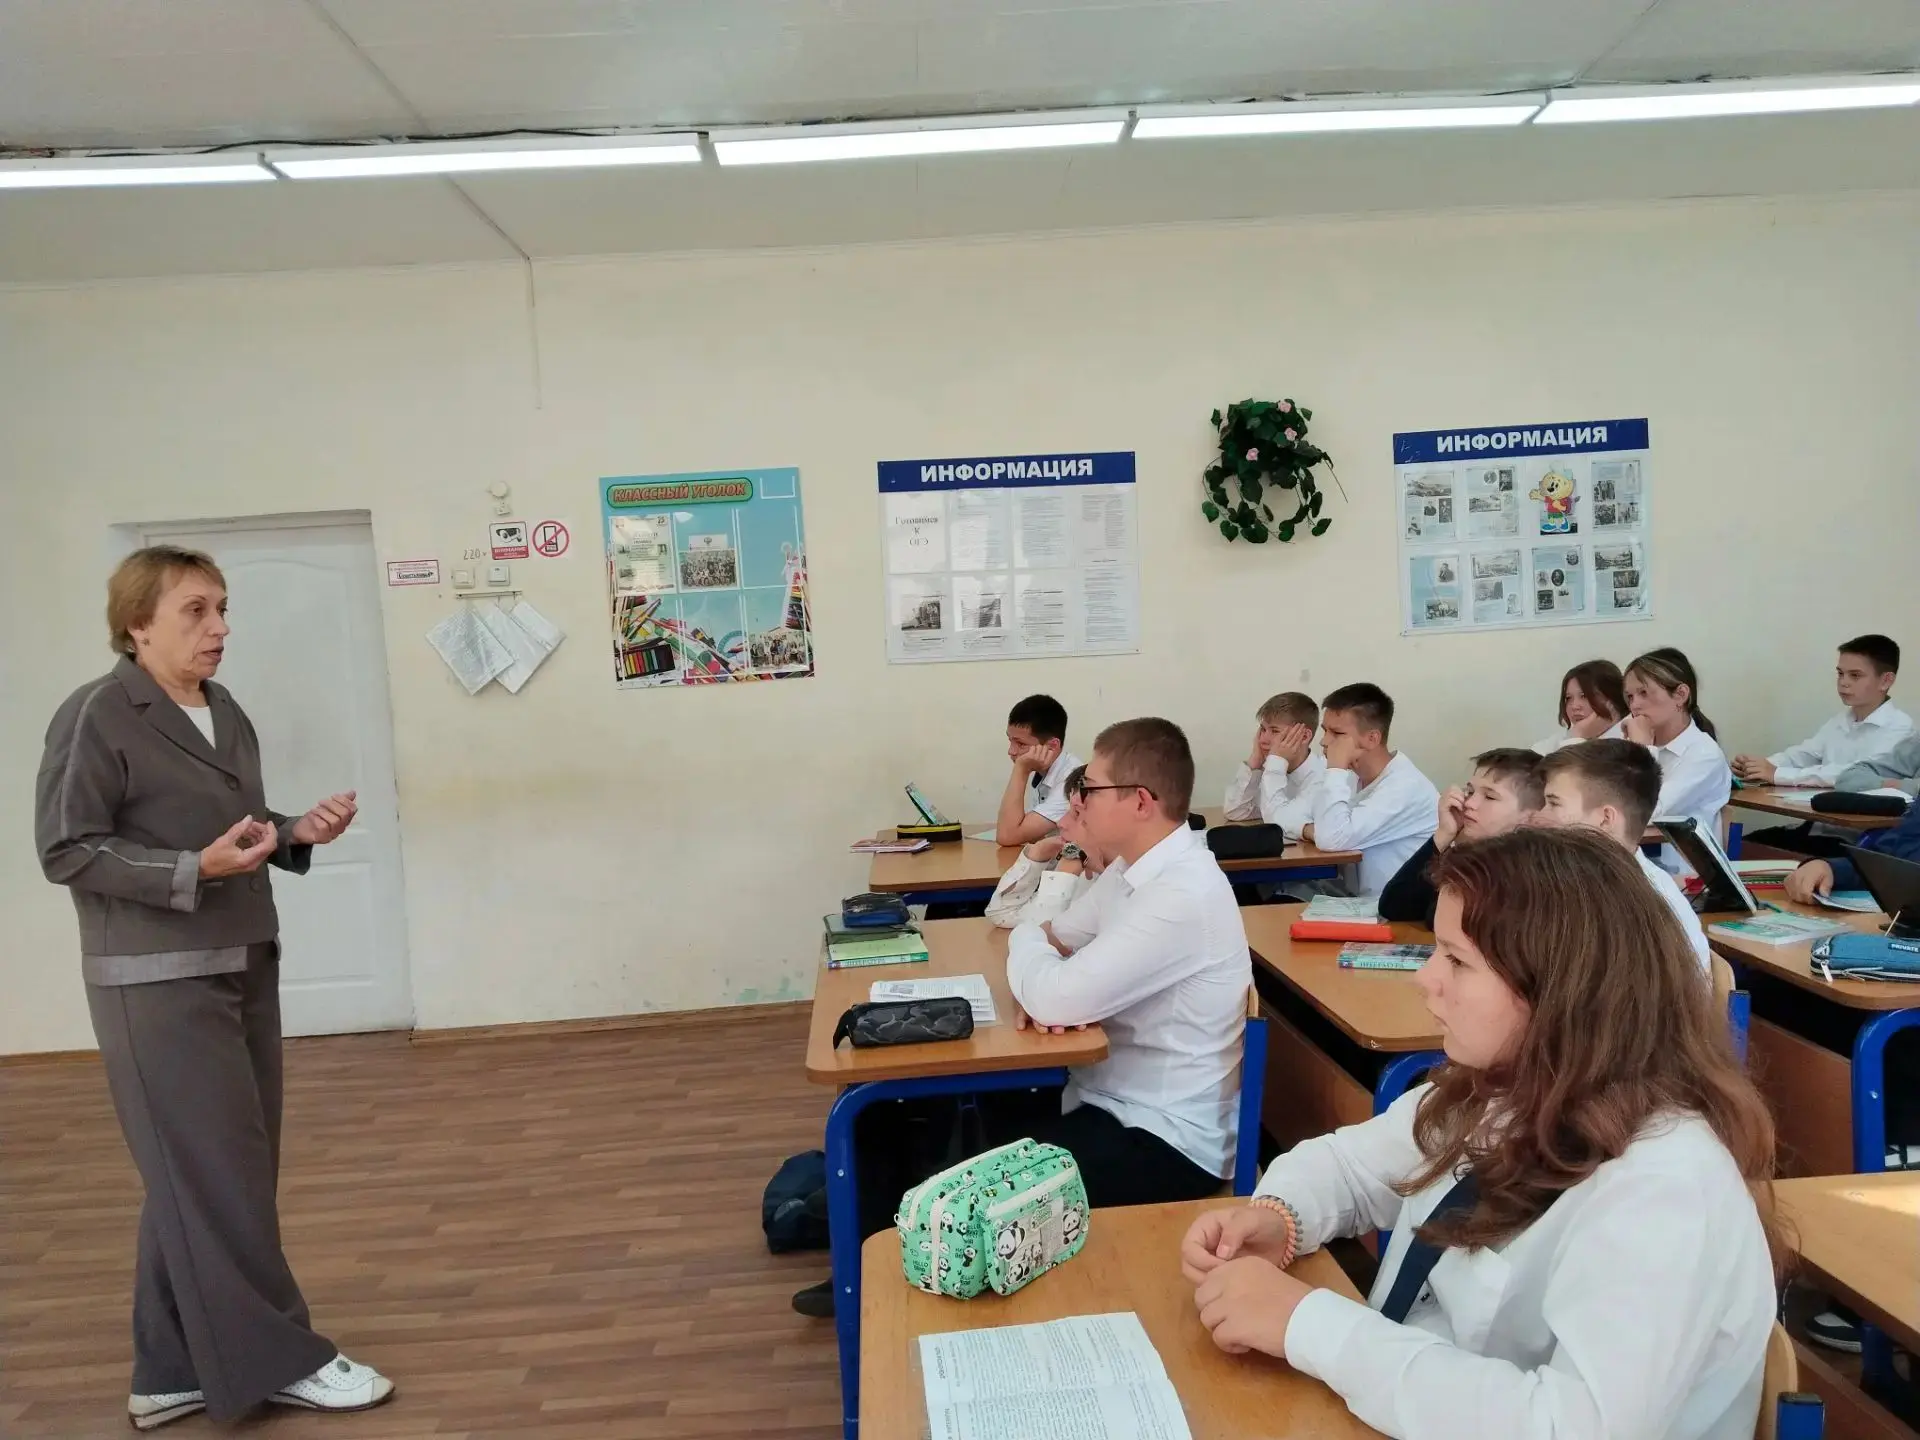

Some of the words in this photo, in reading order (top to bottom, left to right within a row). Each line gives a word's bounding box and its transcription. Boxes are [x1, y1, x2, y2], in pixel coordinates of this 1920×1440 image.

[1436, 426, 1608, 453] ИНФОРМАЦИЯ
[920, 458, 1093, 483] ИНФОРМАЦИЯ
[613, 483, 689, 502] КЛАССНЫЙ
[692, 483, 746, 499] УГОЛОК
[1891, 943, 1919, 953] PRIVATE
